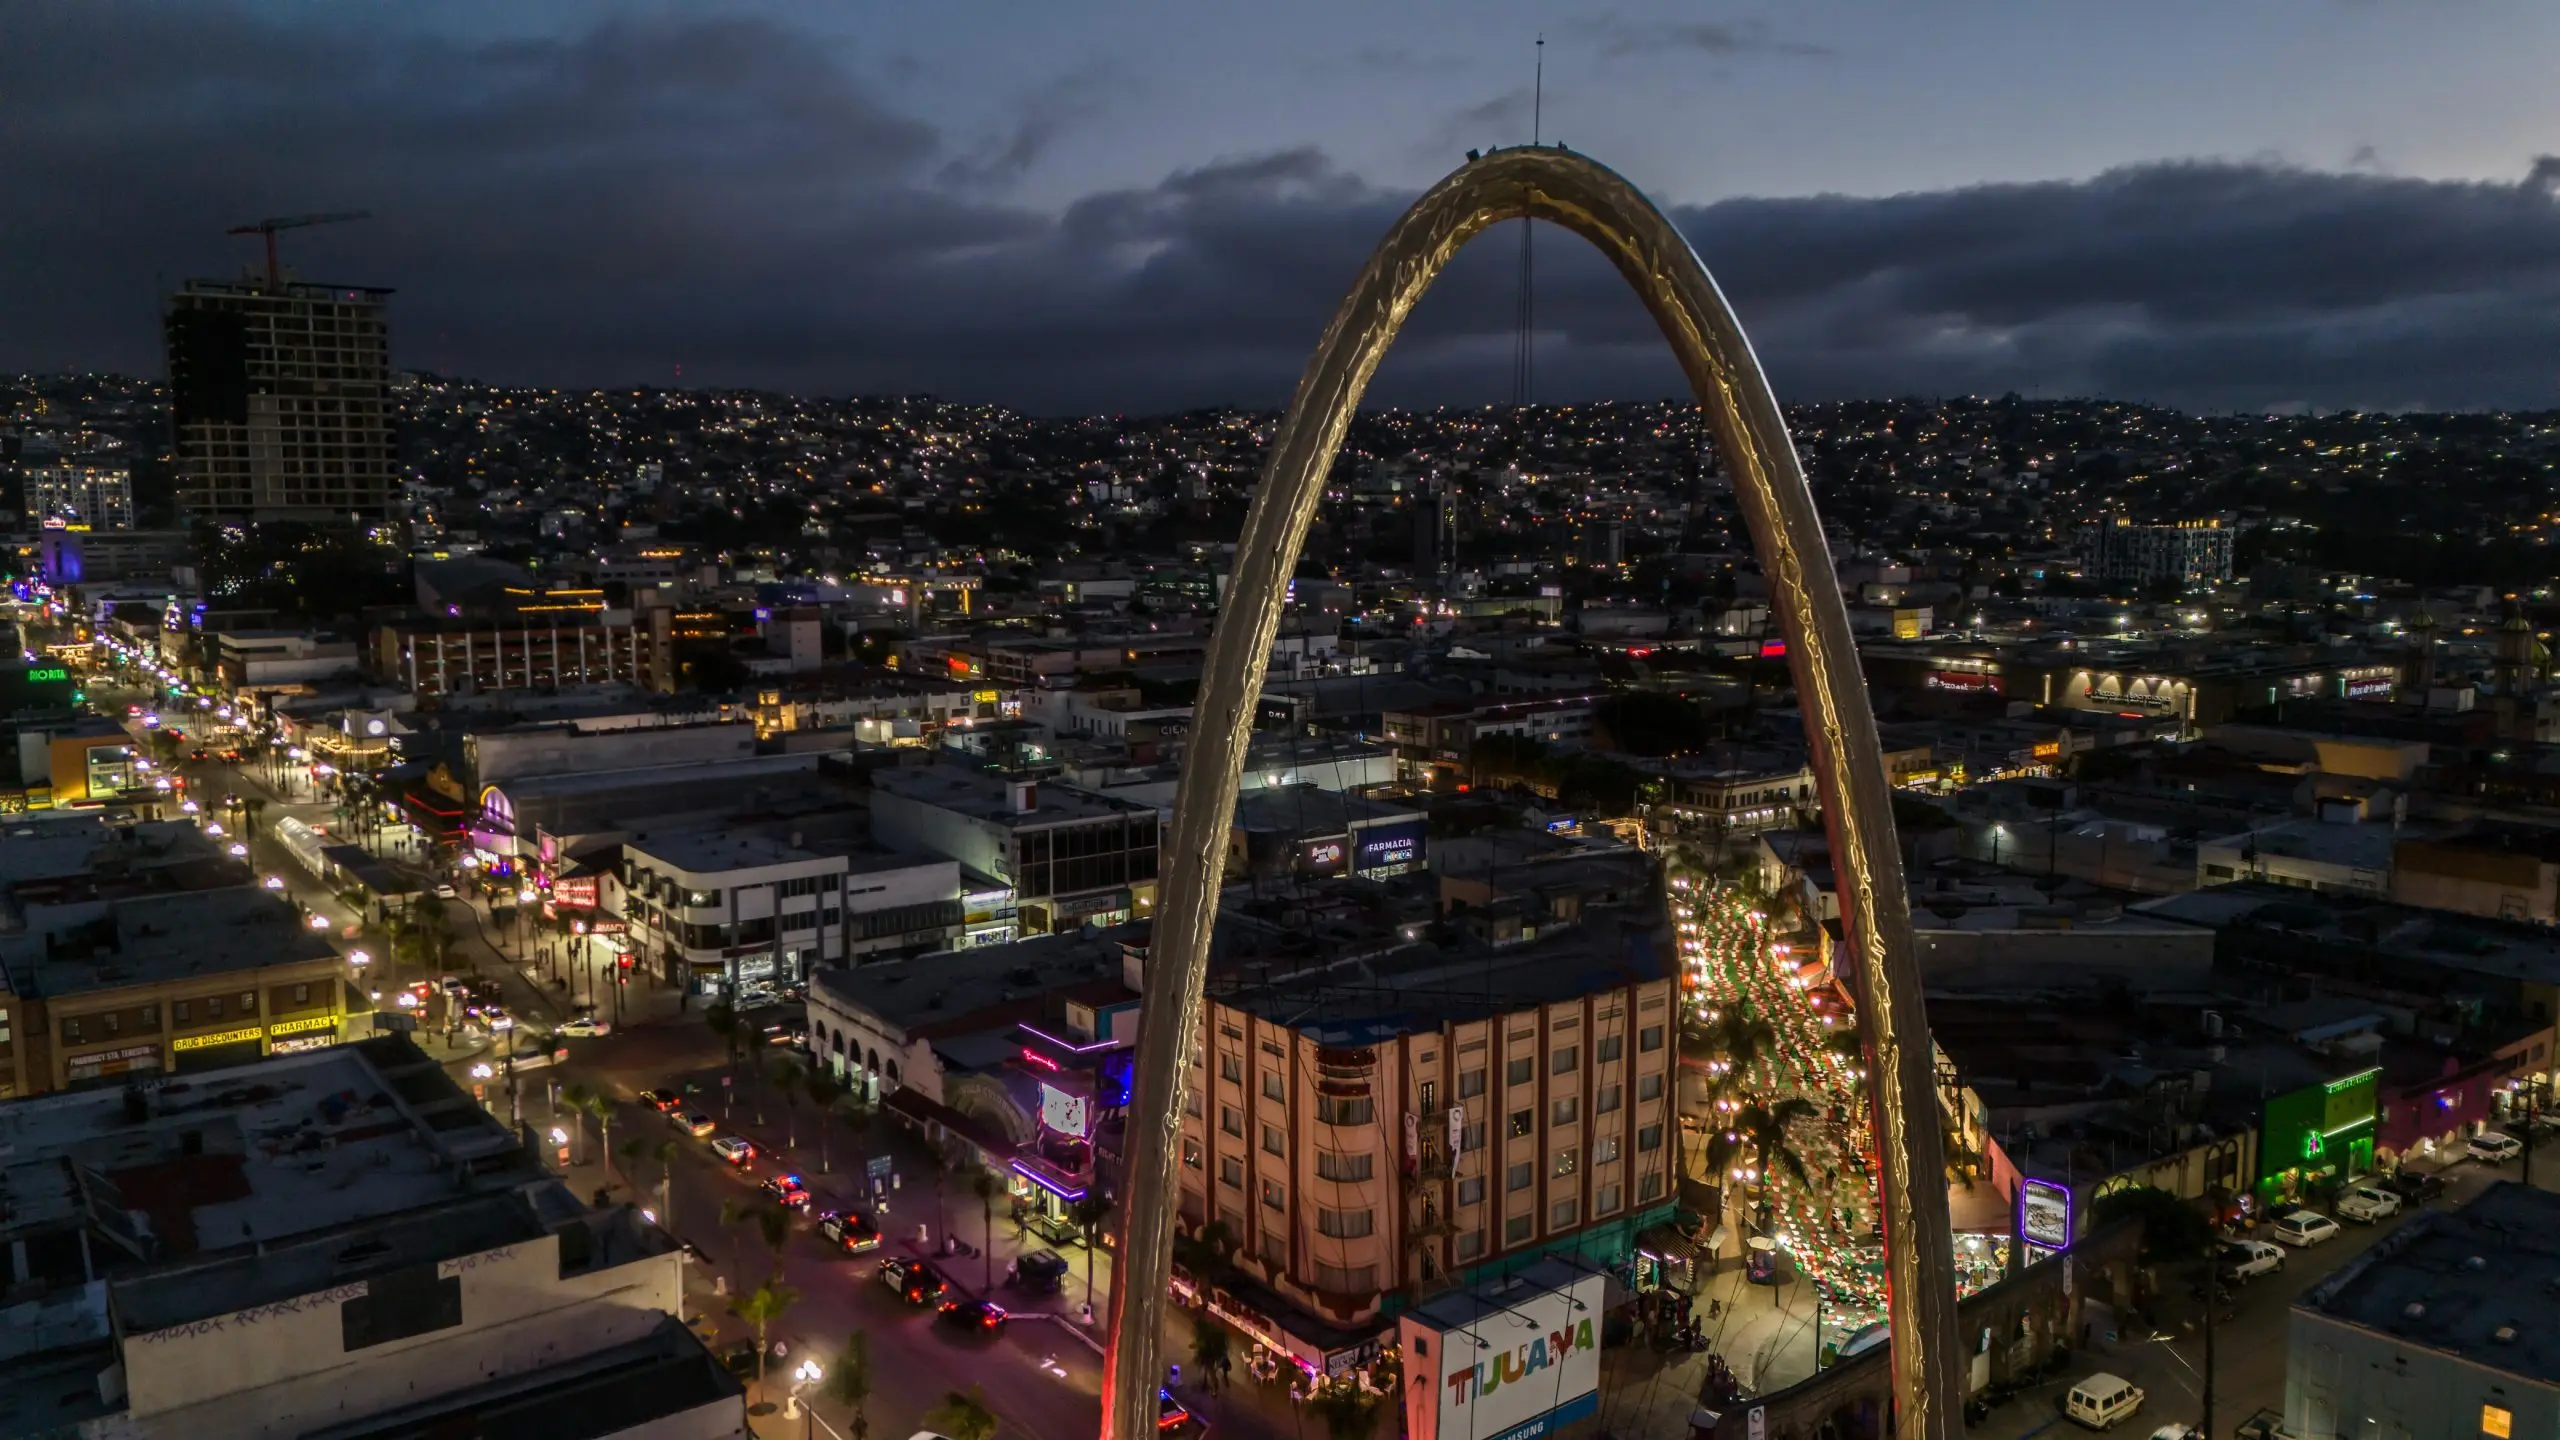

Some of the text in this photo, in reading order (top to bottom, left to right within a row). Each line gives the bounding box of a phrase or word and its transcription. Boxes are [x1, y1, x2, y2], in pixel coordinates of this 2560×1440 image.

[29, 669, 66, 681] RIO RITA
[1369, 838, 1412, 852] FARMACIA
[592, 923, 626, 932] RMACY
[273, 1017, 335, 1034] PHARMACY
[175, 1028, 260, 1050] DRUG DISCOUNTERS
[70, 1053, 104, 1067] PHARMACY
[1447, 1317, 1595, 1407] TIJUANA
[1502, 1421, 1544, 1440] MSUNG
